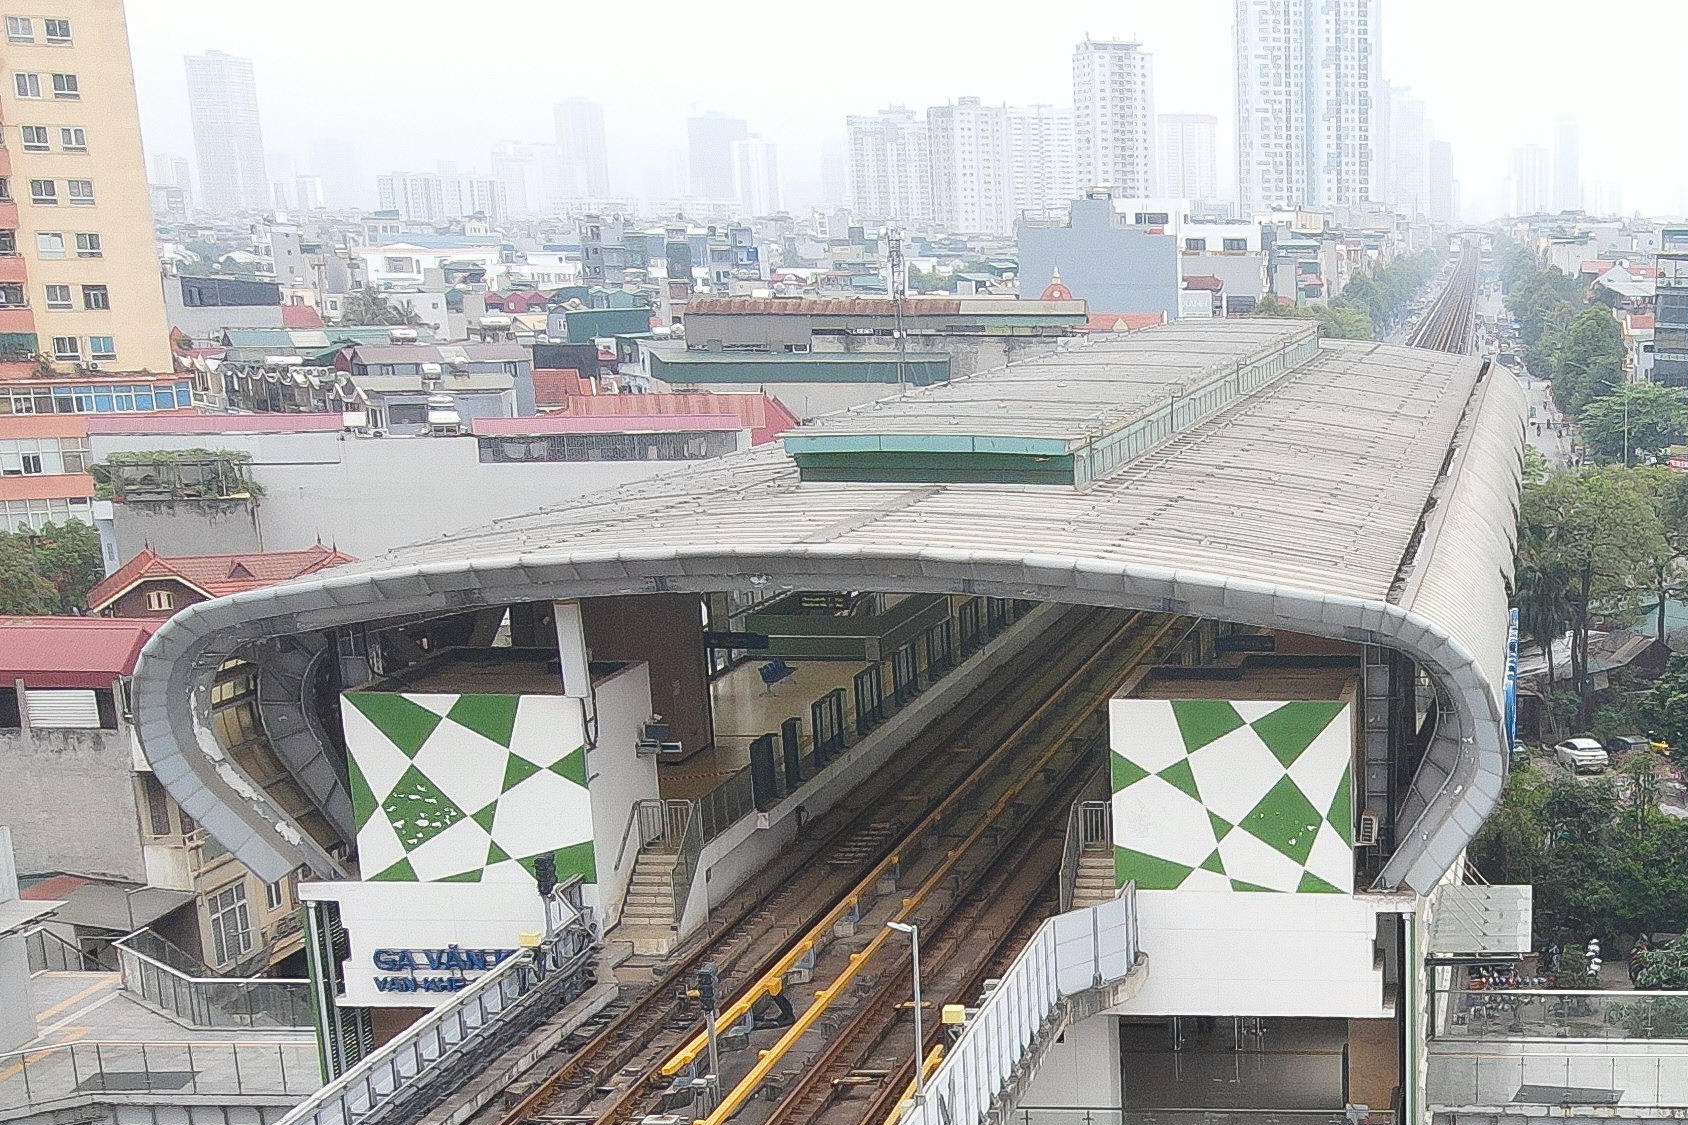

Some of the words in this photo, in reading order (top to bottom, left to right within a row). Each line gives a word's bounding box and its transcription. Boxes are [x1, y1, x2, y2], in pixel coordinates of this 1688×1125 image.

[373, 949, 417, 971] GA
[422, 943, 486, 971] VĂN
[373, 976, 418, 993] VAN
